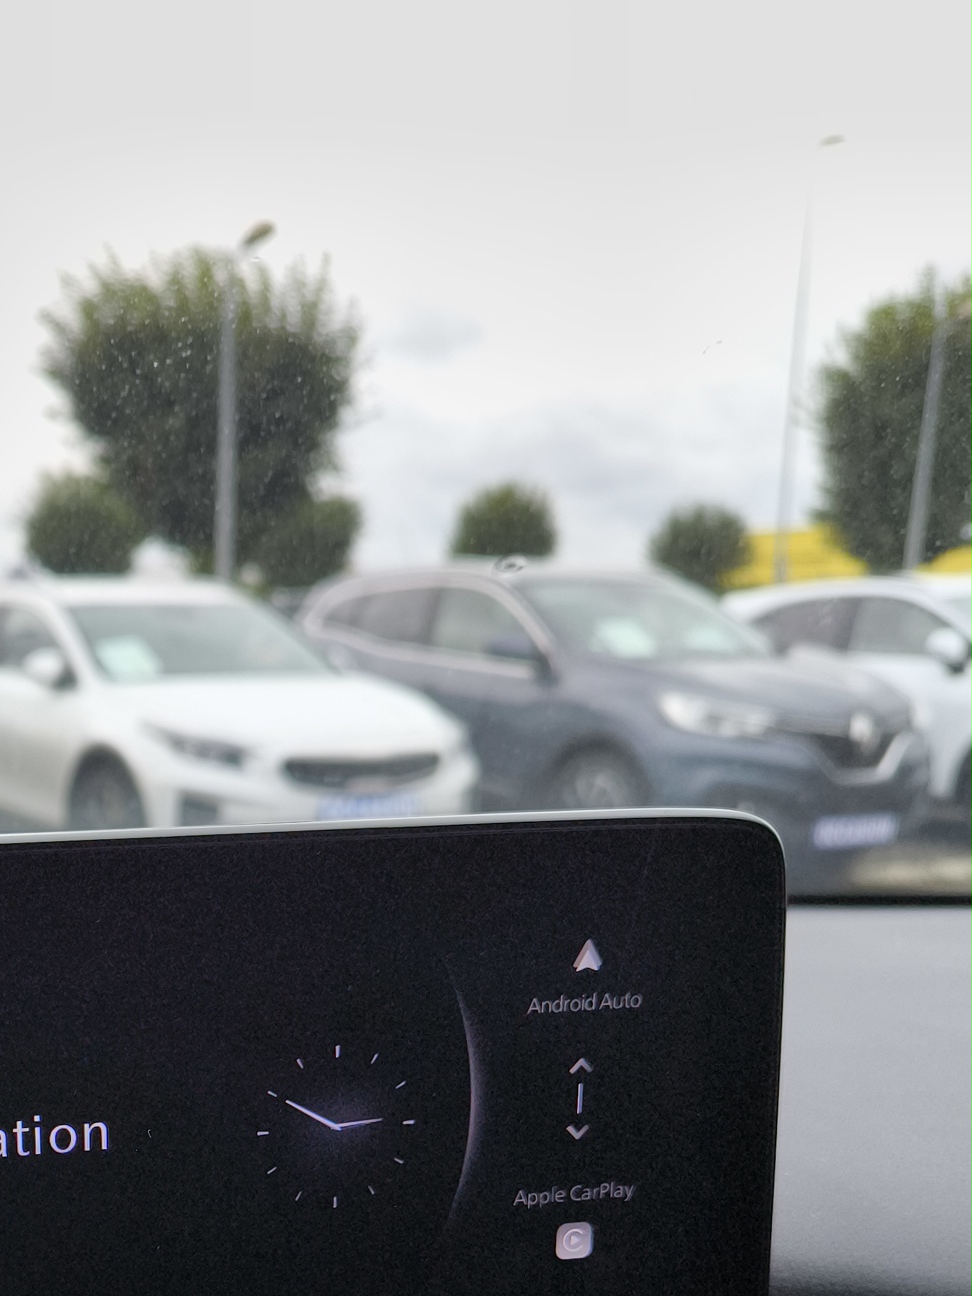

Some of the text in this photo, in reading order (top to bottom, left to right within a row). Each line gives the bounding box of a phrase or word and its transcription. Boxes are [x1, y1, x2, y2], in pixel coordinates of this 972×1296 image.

[527, 991, 643, 1015] Android Auto
[513, 1181, 635, 1209] Apple CarPlay
